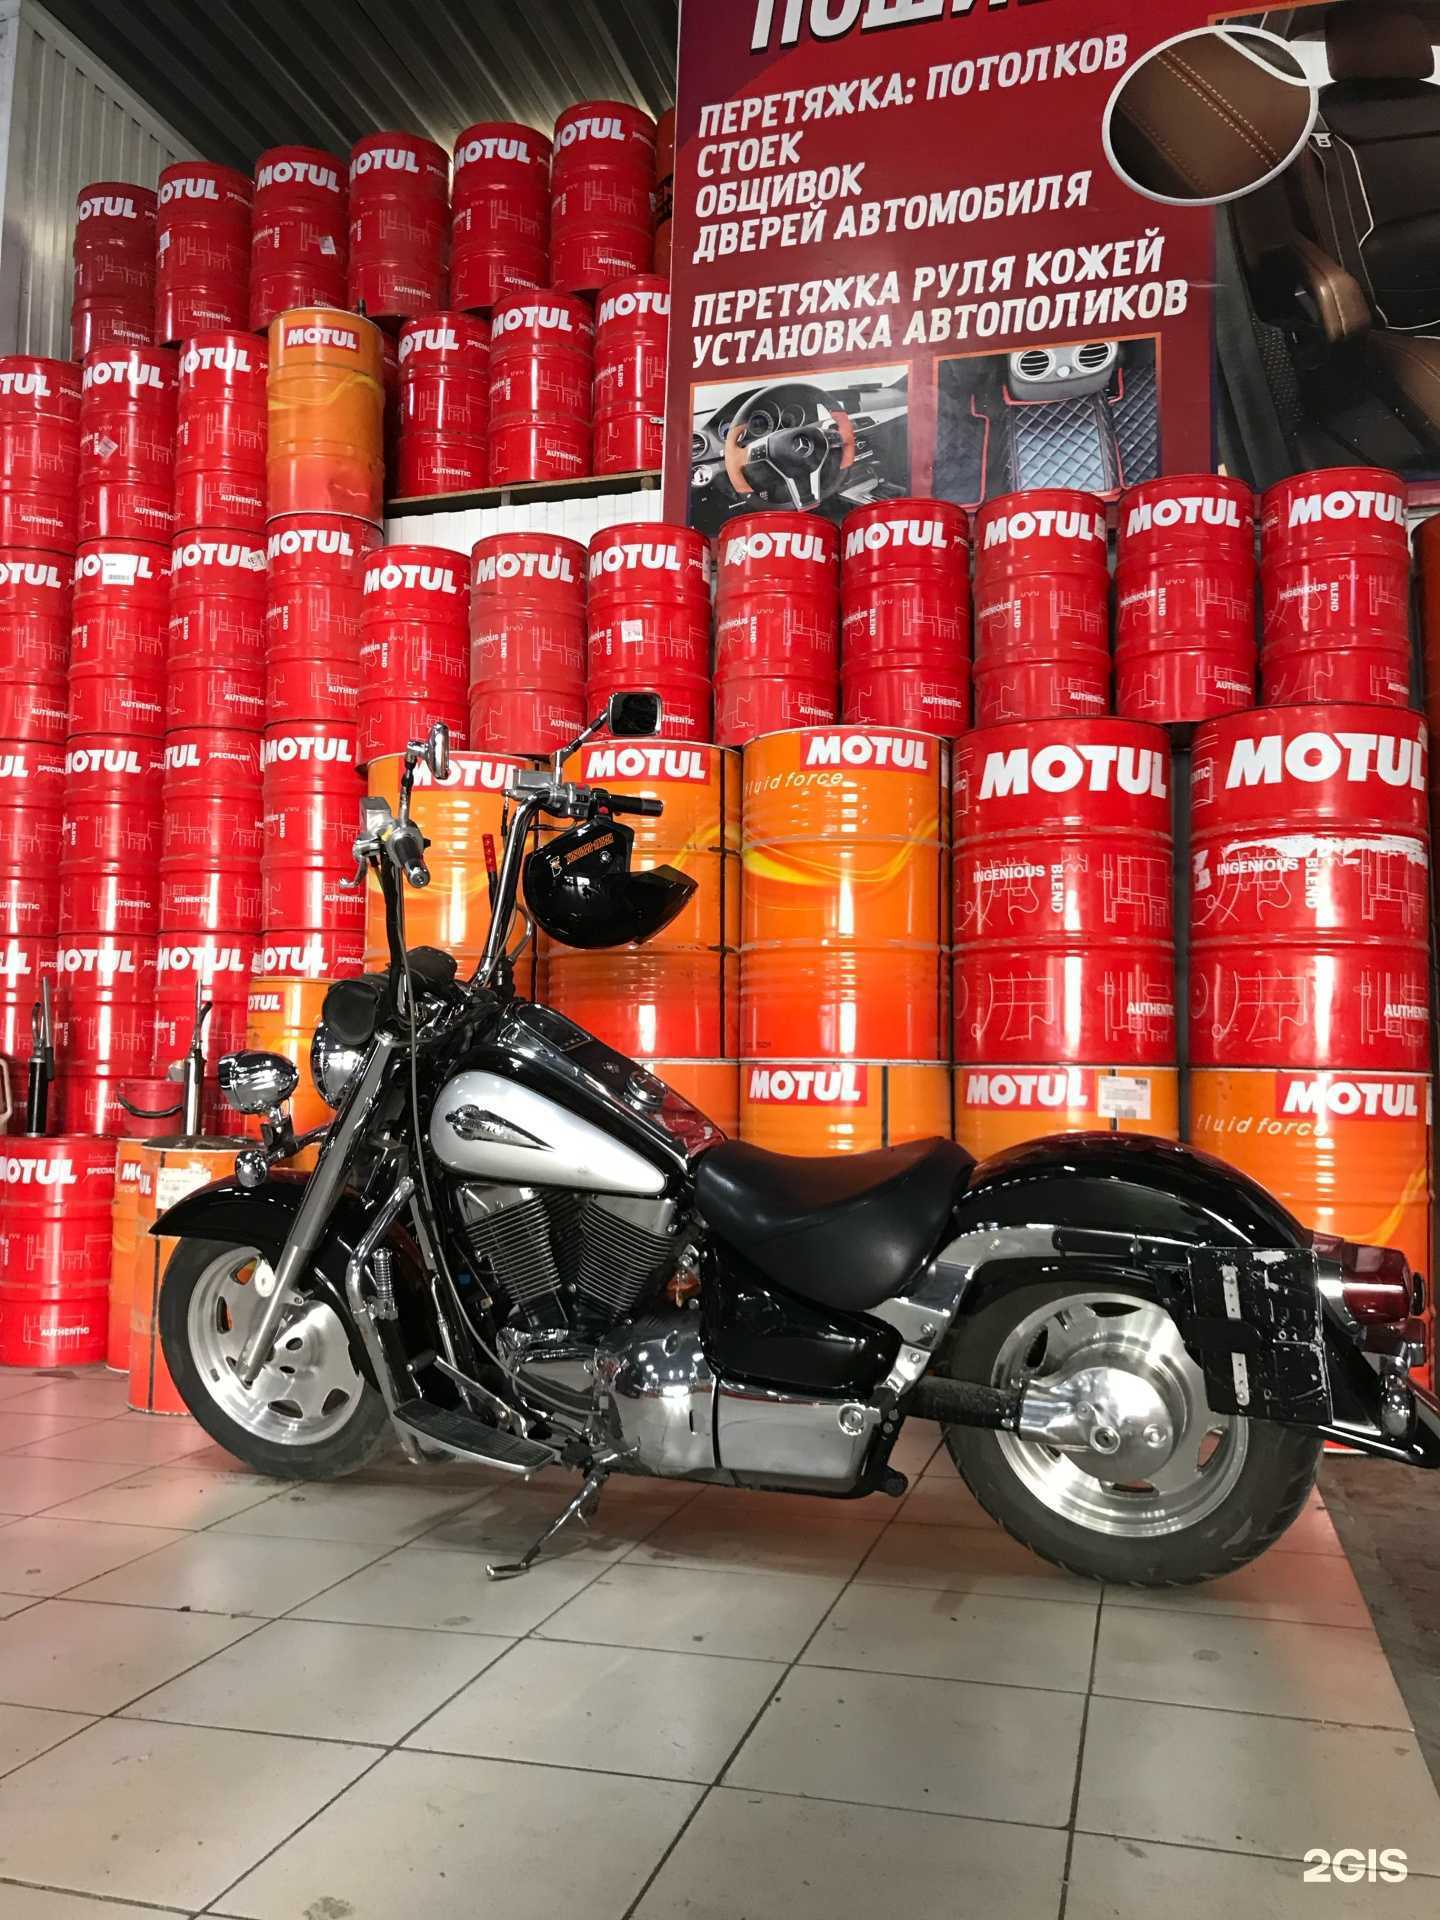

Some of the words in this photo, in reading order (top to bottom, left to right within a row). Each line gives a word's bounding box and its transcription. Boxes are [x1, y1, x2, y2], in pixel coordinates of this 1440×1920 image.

[698, 76, 916, 138] ПЕРЕТЯЖКА:
[926, 34, 1127, 100] ПОТОЛКОВ
[697, 132, 802, 178] СТОЕК
[257, 162, 340, 192] MOTUL
[695, 163, 865, 218] ОБЩИВОК
[79, 197, 137, 221] OTUL
[693, 203, 827, 263] ДВЕРЕЙ
[833, 171, 1091, 240] АВТОМОБИЛЯ
[598, 257, 636, 270] AUTHENTIC
[691, 271, 900, 327] ПЕРЕТЯЖКА
[914, 256, 1016, 301] РУЛЯ
[1025, 228, 1165, 286] КОЖЕЙ
[394, 286, 431, 299] AUTHENTIC
[192, 310, 231, 322] AUTHENTIC
[492, 306, 573, 338] MOTUL
[598, 292, 670, 326] MOTU
[692, 313, 891, 368] УСТАНОВКА
[902, 279, 1188, 346] АВТОПОЛИКОВ
[287, 327, 357, 349] MOTUL
[0, 373, 51, 397] TUL
[546, 449, 582, 463] AUTHENTIC
[432, 468, 471, 477] AUTHENTIC
[221, 494, 262, 507] AUTHENTIC
[21, 515, 64, 527] AUTHENTIC
[984, 511, 1094, 550] MOTUL
[1126, 497, 1240, 538] MOTUL
[268, 530, 354, 559] MOTUL
[845, 520, 948, 560] MOTUL
[476, 553, 573, 585] MOTUL
[589, 544, 680, 581] MOTUL
[363, 565, 457, 595] MOTUL
[1158, 587, 1166, 617] BLEND
[1330, 581, 1339, 612] BLEND
[121, 701, 161, 712] AUTHENTIC
[224, 694, 264, 705] AUTHENTIC
[800, 707, 834, 719] AUTHENTIC
[922, 696, 962, 708] AUTHENTIC
[662, 715, 695, 725] UTHENTIC
[208, 752, 251, 761] SPECIALIST
[265, 736, 352, 763] MOTUL
[585, 748, 705, 780] MOTUL
[806, 735, 928, 769] MOTUL
[1225, 732, 1426, 791] MOTUL
[785, 771, 843, 788] force
[979, 744, 1167, 800] MOTUL
[973, 865, 1045, 883] INGENIOUS
[1217, 857, 1299, 875] INGENIOUS
[325, 895, 364, 904] AUTHENTIC
[1051, 864, 1064, 913] BLEND
[749, 1071, 861, 1101] MOTUL
[966, 1073, 1088, 1107] MOTUL
[1283, 1081, 1418, 1116] MOTUL
[1257, 1117, 1328, 1136] force
[41, 1327, 90, 1337] AUTHENTIC
